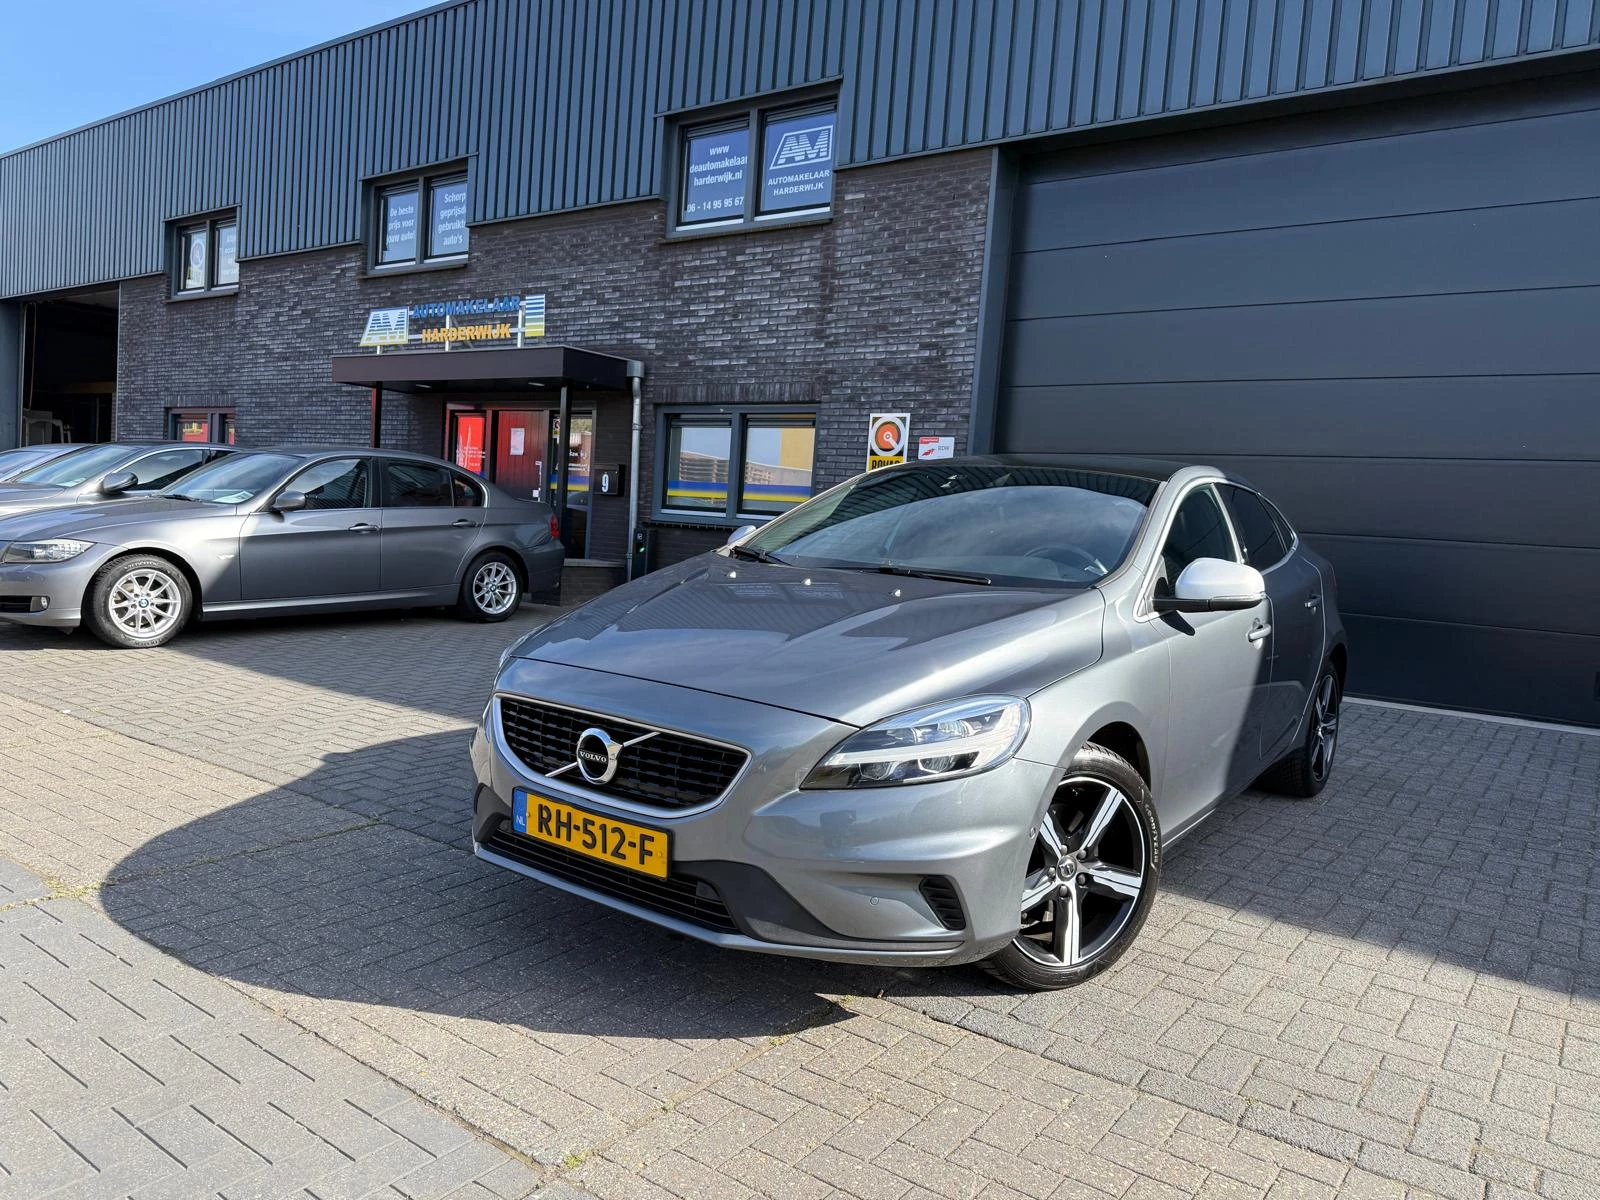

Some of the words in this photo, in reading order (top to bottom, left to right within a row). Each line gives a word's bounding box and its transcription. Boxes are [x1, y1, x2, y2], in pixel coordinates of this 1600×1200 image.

[709, 145, 730, 155] www
[694, 169, 743, 187] harderwijk.nl
[768, 169, 830, 186] AUTOMAKELAAR
[773, 181, 824, 196] HARDERWIJK
[702, 202, 712, 211] 14
[713, 200, 723, 210] 95
[724, 199, 734, 208] 95
[735, 197, 745, 206] 67
[412, 295, 521, 319] AUTOMAKELAAR
[421, 323, 511, 343] HARDERWIJK
[601, 473, 609, 493] 9
[579, 749, 608, 763] VOLVO
[516, 815, 526, 827] NL
[537, 803, 655, 866] RH-512-F
